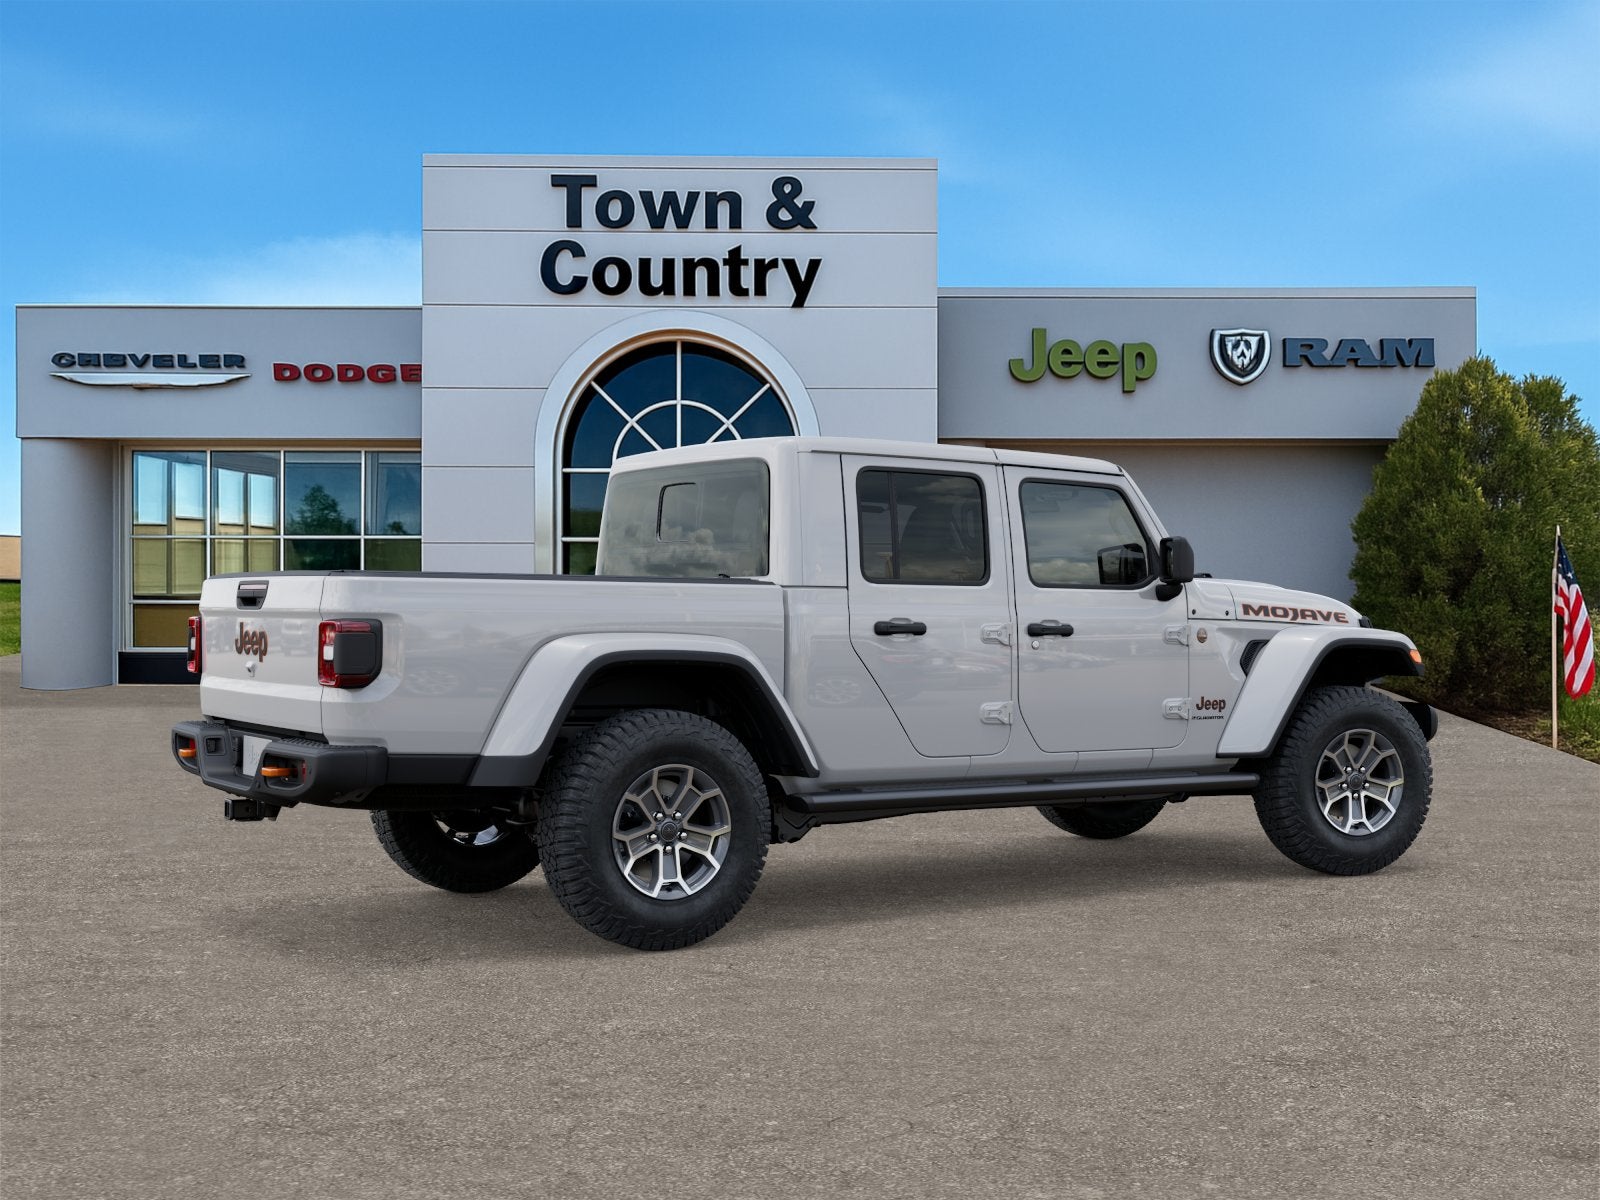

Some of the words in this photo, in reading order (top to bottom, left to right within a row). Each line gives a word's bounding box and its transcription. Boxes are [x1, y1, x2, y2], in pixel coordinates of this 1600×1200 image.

[551, 174, 742, 229] Town
[765, 176, 818, 230] &
[540, 239, 823, 308] Country
[1009, 328, 1157, 393] Jeep
[1282, 337, 1435, 368] RAM
[273, 362, 422, 383] DODGE
[1241, 603, 1349, 624] MOJAVE
[235, 622, 268, 662] Jeep
[1195, 696, 1226, 712] Jeep
